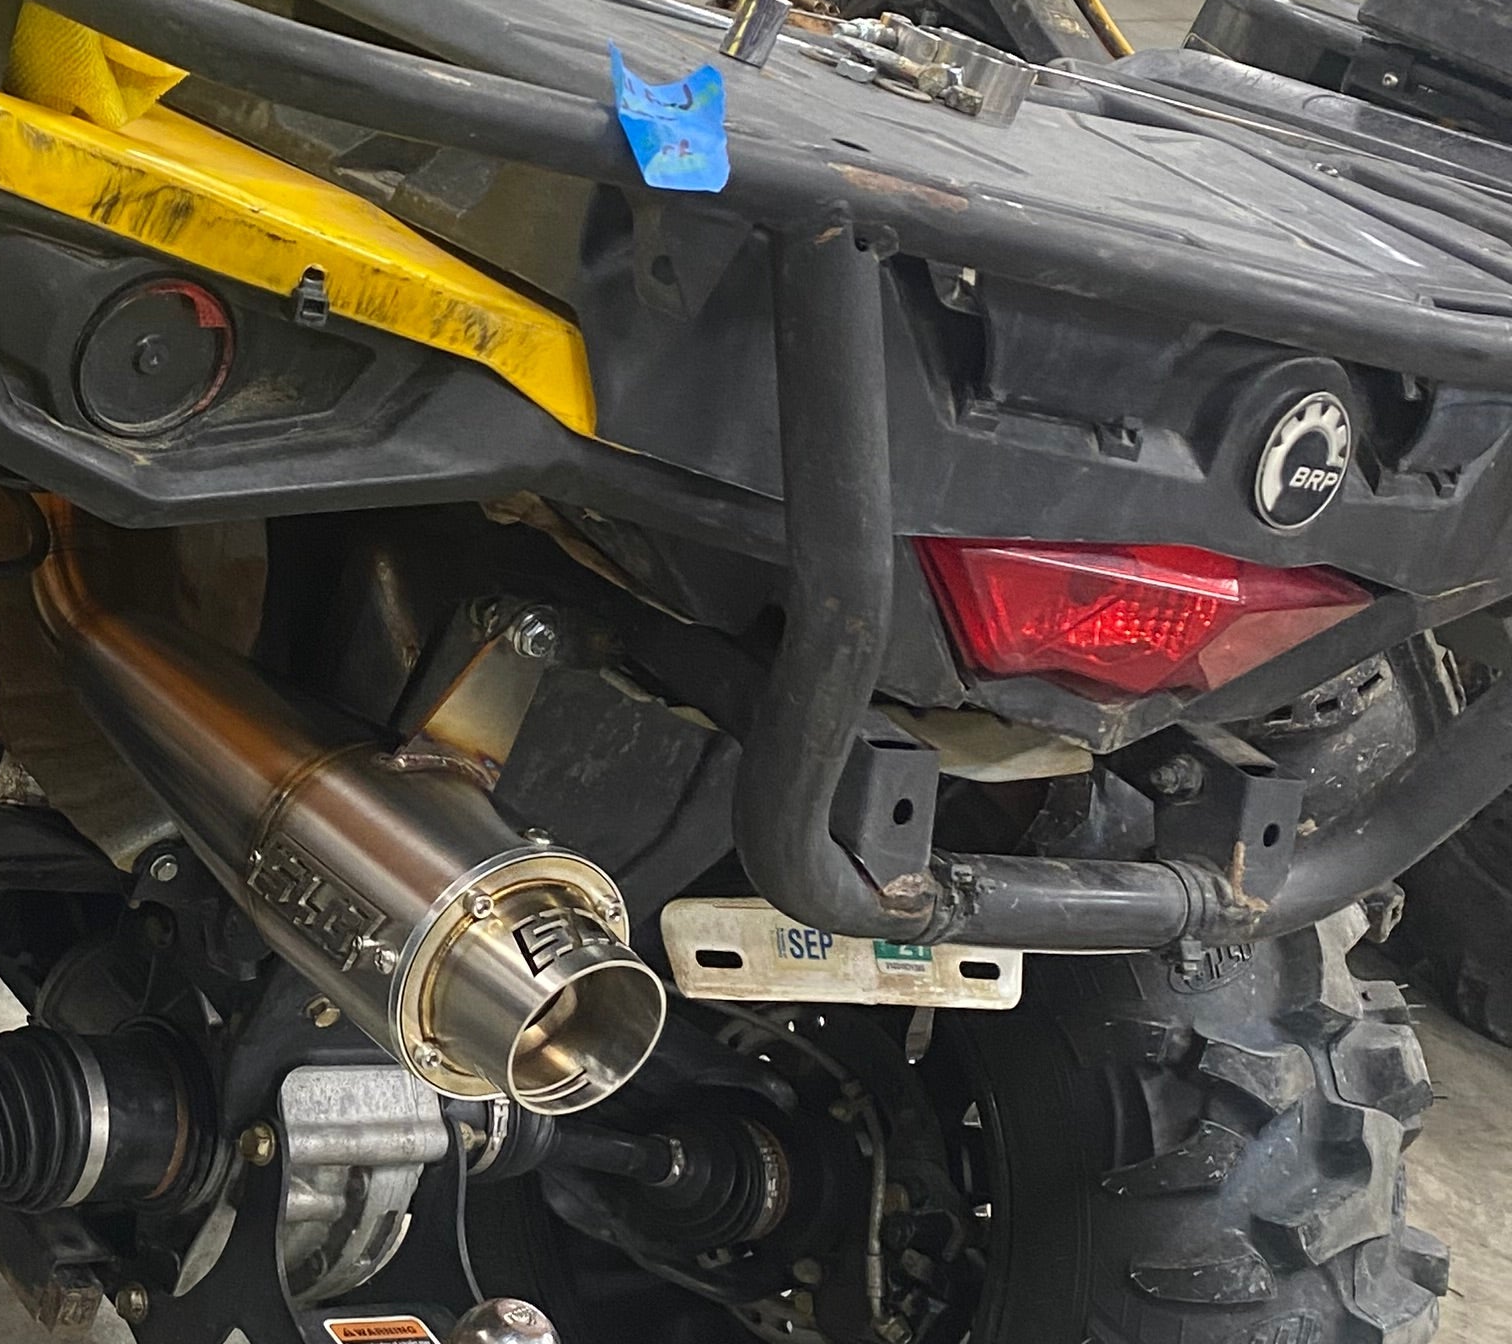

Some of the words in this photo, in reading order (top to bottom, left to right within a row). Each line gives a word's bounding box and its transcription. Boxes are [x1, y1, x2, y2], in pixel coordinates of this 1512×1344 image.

[1289, 466, 1339, 493] BRP
[788, 928, 833, 960] SEP
[355, 1325, 418, 1338] WARNING
